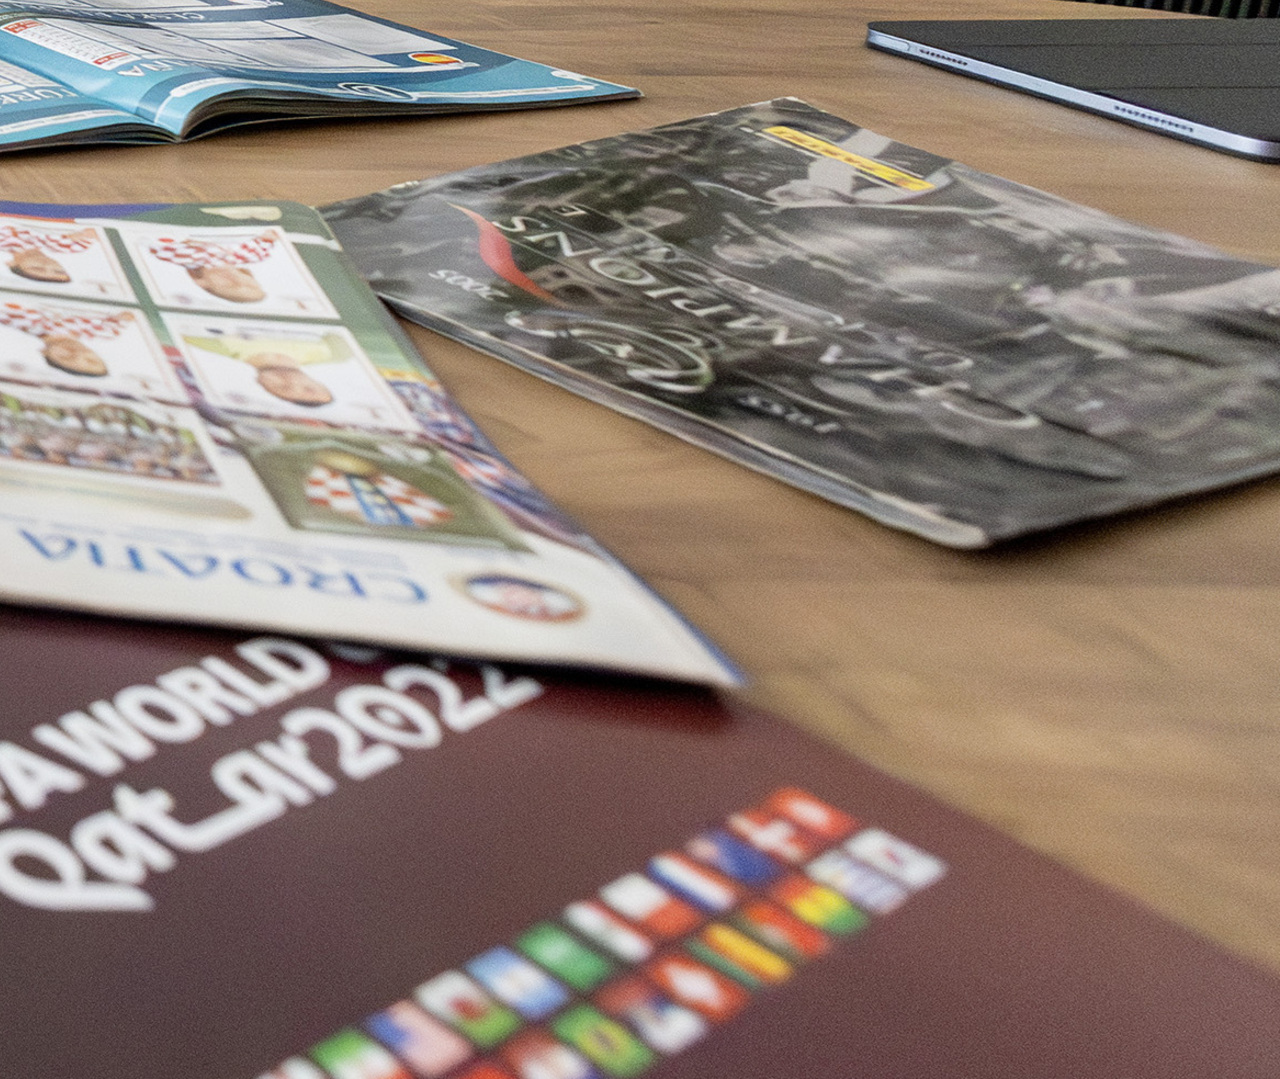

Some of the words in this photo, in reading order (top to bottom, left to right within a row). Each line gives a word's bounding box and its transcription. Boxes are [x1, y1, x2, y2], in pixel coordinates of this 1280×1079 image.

[428, 268, 510, 300] 2005
[490, 214, 1037, 431] CHAMPIONS
[17, 527, 429, 606] CROATIA
[33, 635, 331, 777] WORLD
